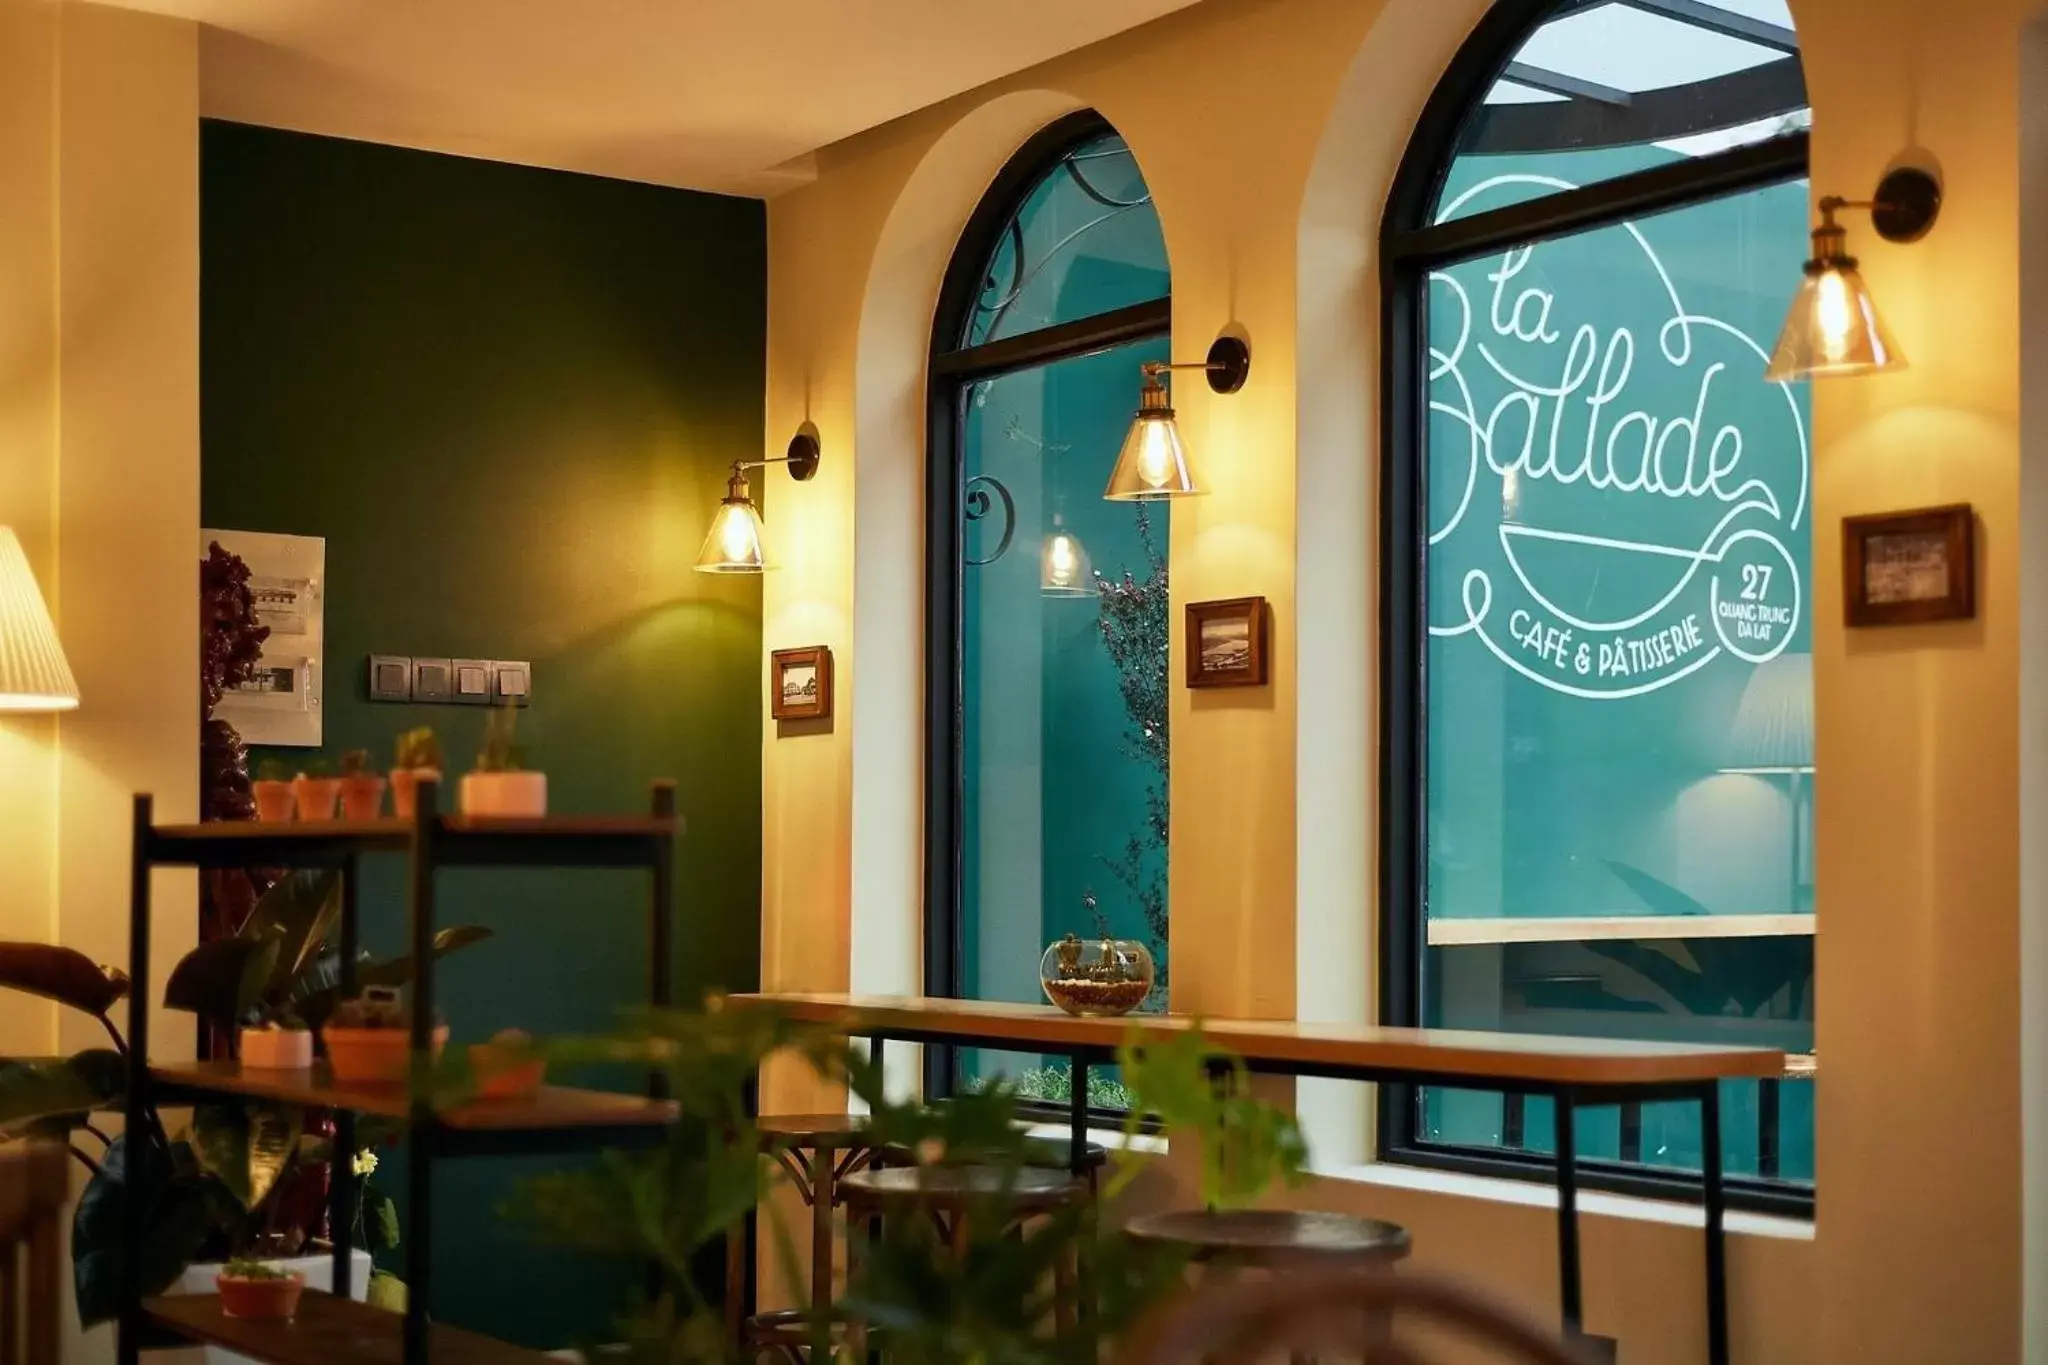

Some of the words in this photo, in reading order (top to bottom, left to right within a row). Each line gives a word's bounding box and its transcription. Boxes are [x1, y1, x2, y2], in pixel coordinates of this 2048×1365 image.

[1740, 563, 1773, 600] 27
[1719, 601, 1757, 621] QUANG
[1758, 604, 1790, 624] TRUNG
[1509, 609, 1573, 669] CAFÉ
[1574, 642, 1591, 675] &
[1598, 613, 1704, 677] PÂTISSERIE
[1738, 620, 1753, 637] DA
[1754, 623, 1772, 641] LAT
